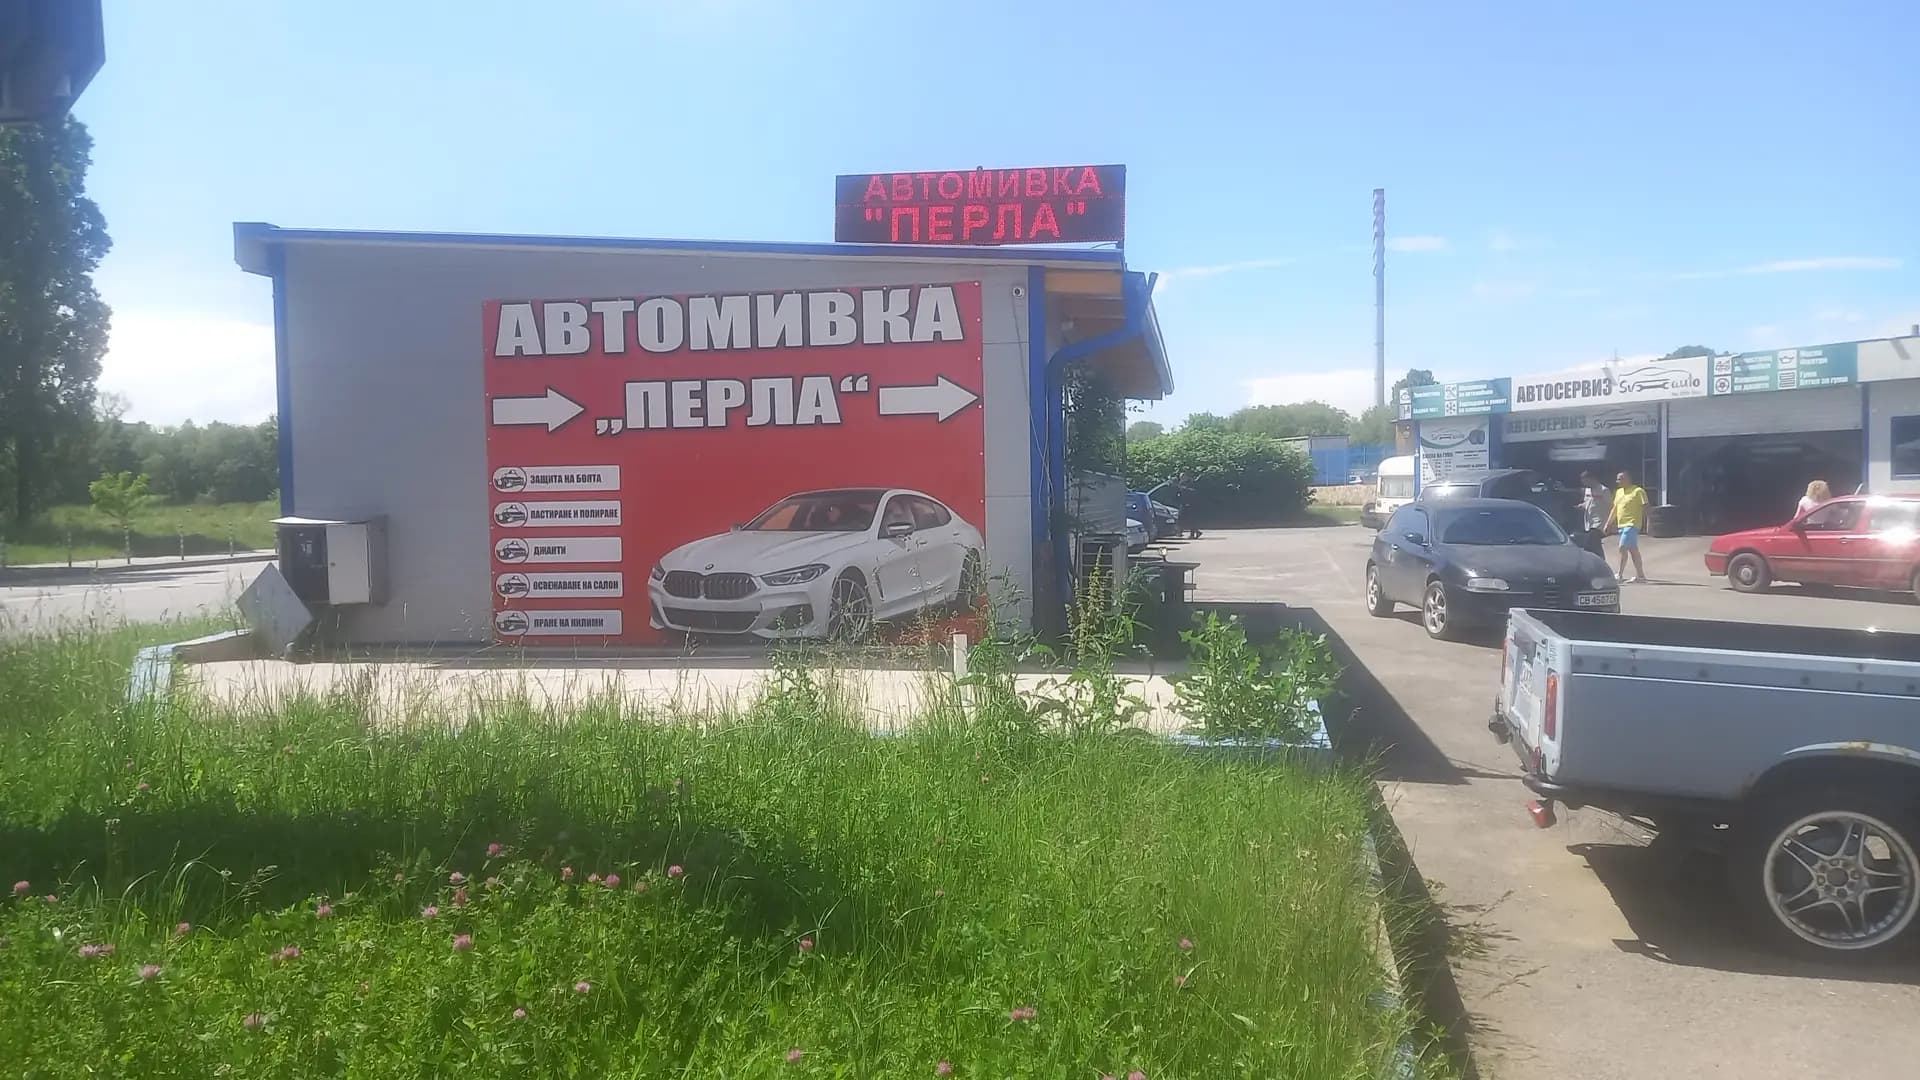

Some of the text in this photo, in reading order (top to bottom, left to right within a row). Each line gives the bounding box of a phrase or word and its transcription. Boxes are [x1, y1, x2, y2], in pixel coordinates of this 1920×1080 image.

[863, 167, 1102, 203] АВТОМИВКА
[864, 202, 1087, 242] "ПЕРЛА"
[495, 286, 964, 358] АВТОМИВКА
[1516, 377, 1613, 404] АВТОСЕРВИЗ
[530, 474, 563, 485] ЗАЩИТА
[564, 475, 575, 484] НА
[530, 509, 573, 519] ПАСТИРАНЕ
[580, 508, 618, 518] ПОЛИРАНЕ
[582, 580, 592, 590] НА
[593, 580, 619, 590] САЛОН
[534, 618, 558, 628] ПРАНЕ
[559, 618, 570, 628] НА
